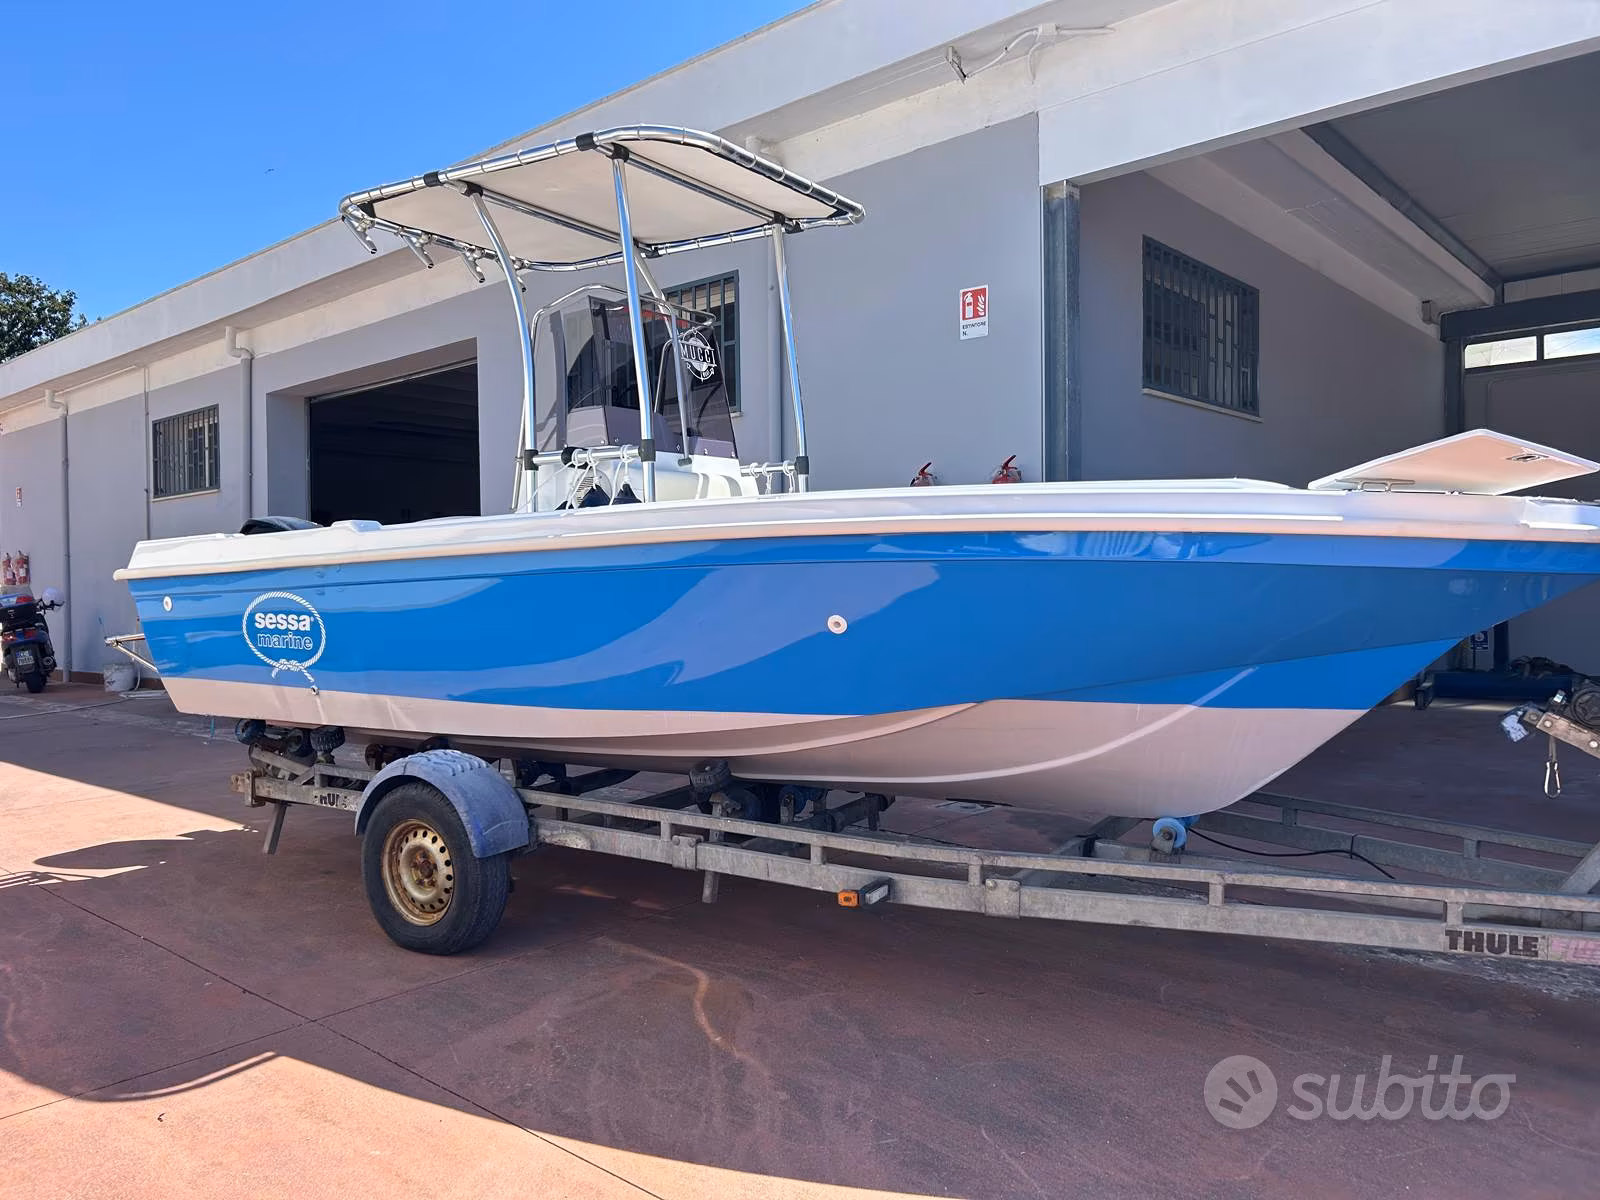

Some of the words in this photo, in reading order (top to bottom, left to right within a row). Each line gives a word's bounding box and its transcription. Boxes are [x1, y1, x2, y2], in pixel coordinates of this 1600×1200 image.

[680, 343, 715, 365] MUCCI
[254, 612, 311, 631] sessa
[257, 631, 313, 650] marine
[1445, 929, 1538, 958] THULE
